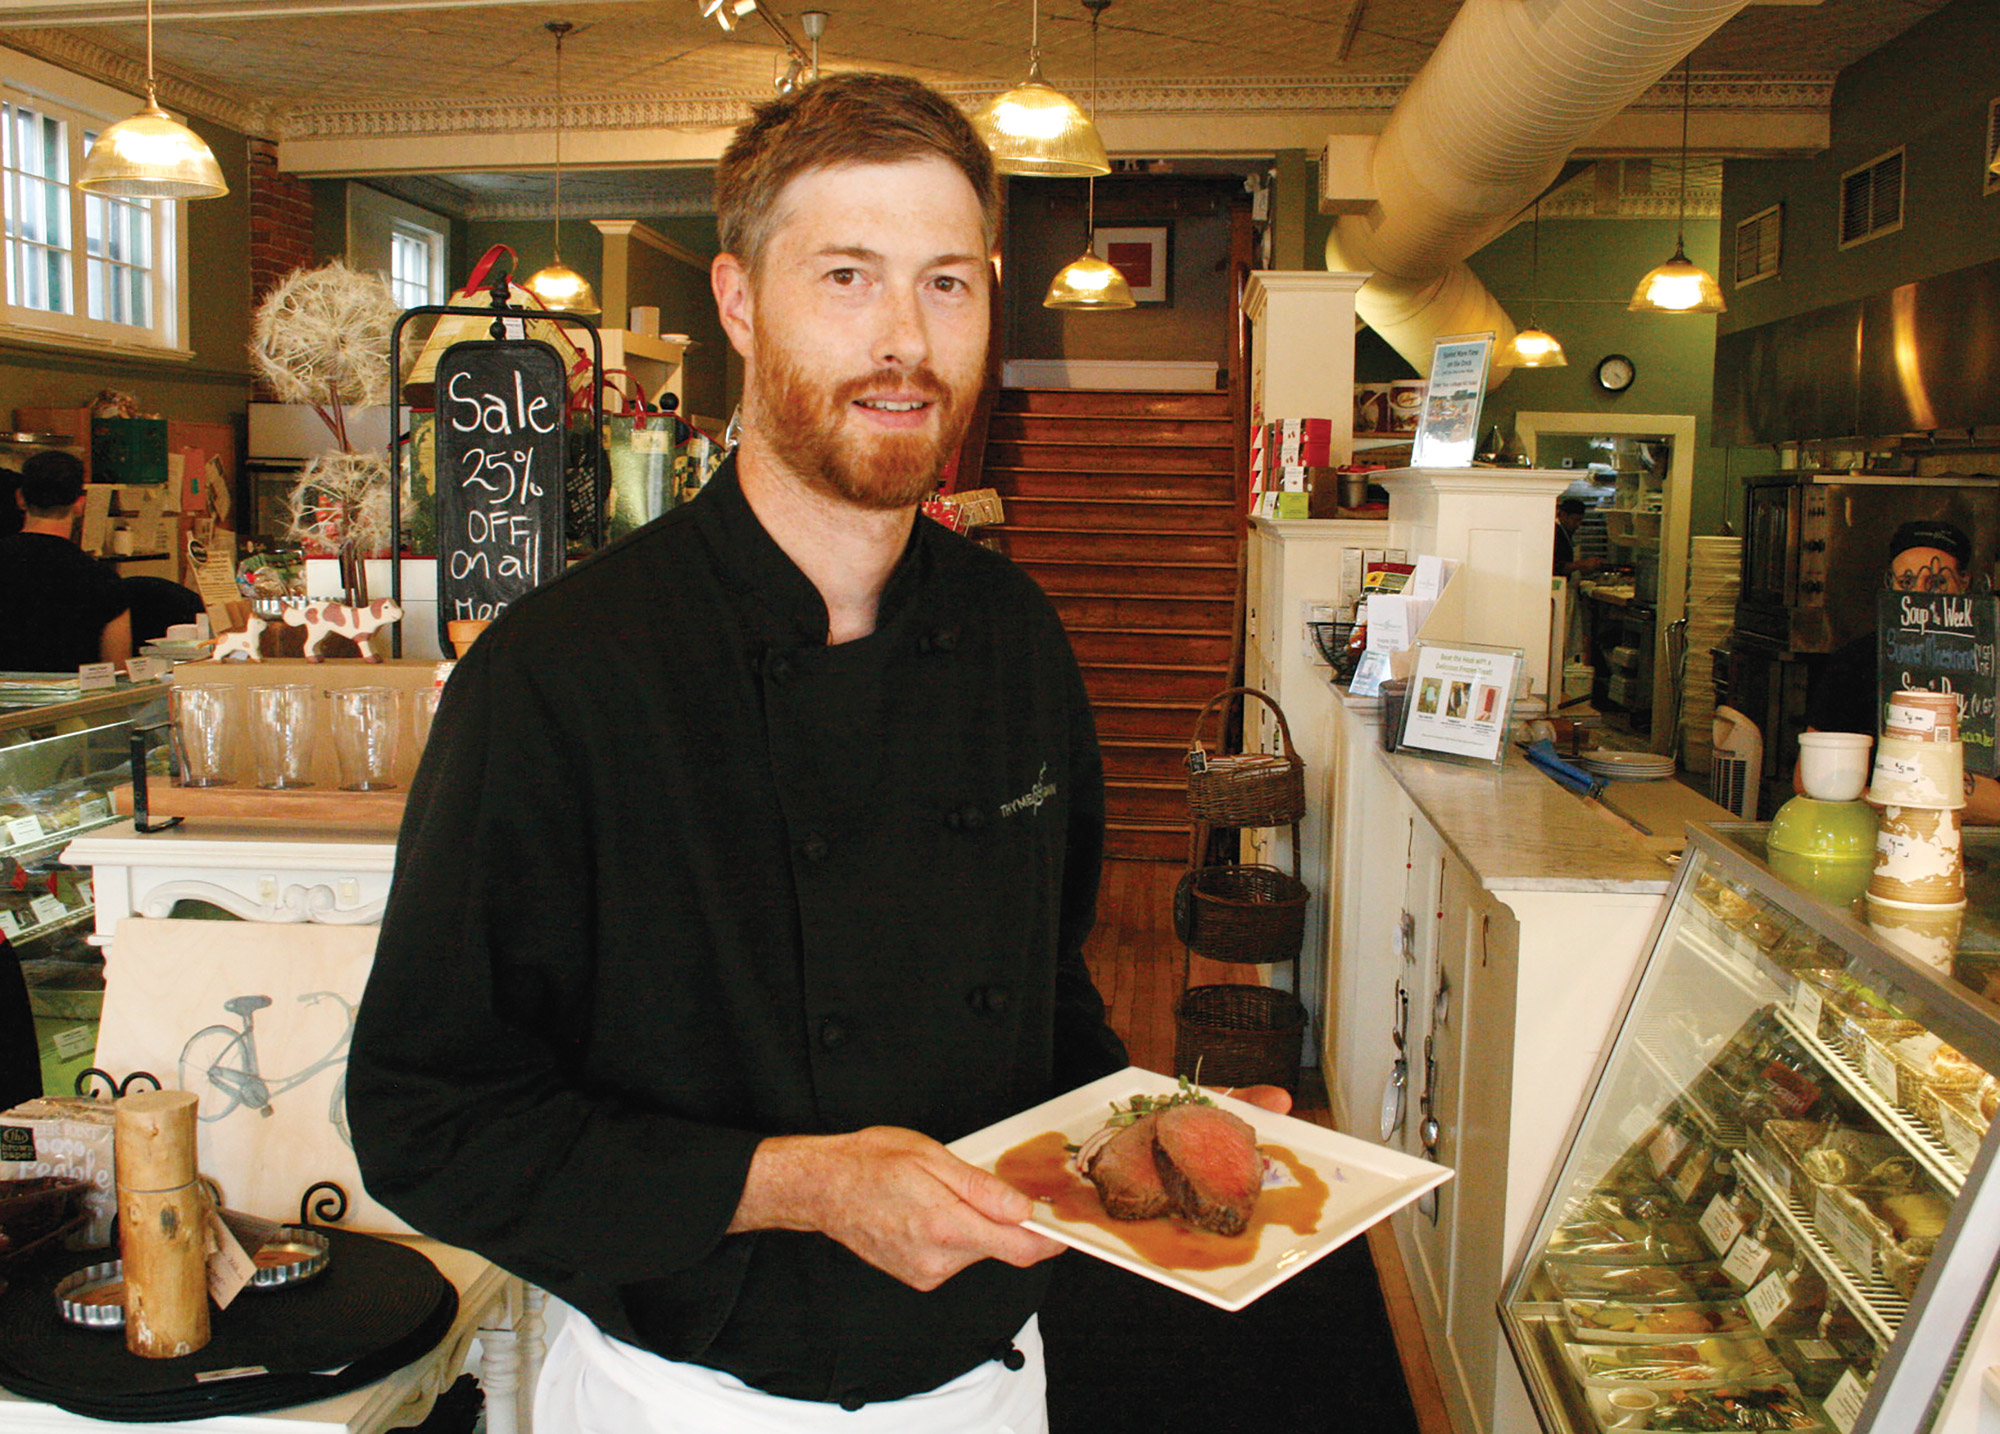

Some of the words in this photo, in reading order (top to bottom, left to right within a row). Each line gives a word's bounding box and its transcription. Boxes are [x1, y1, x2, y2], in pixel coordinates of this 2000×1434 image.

[449, 370, 555, 435] Sale
[462, 447, 544, 505] 25%
[468, 510, 533, 546] OFF
[498, 530, 540, 588] all
[1900, 595, 1929, 635] Soup
